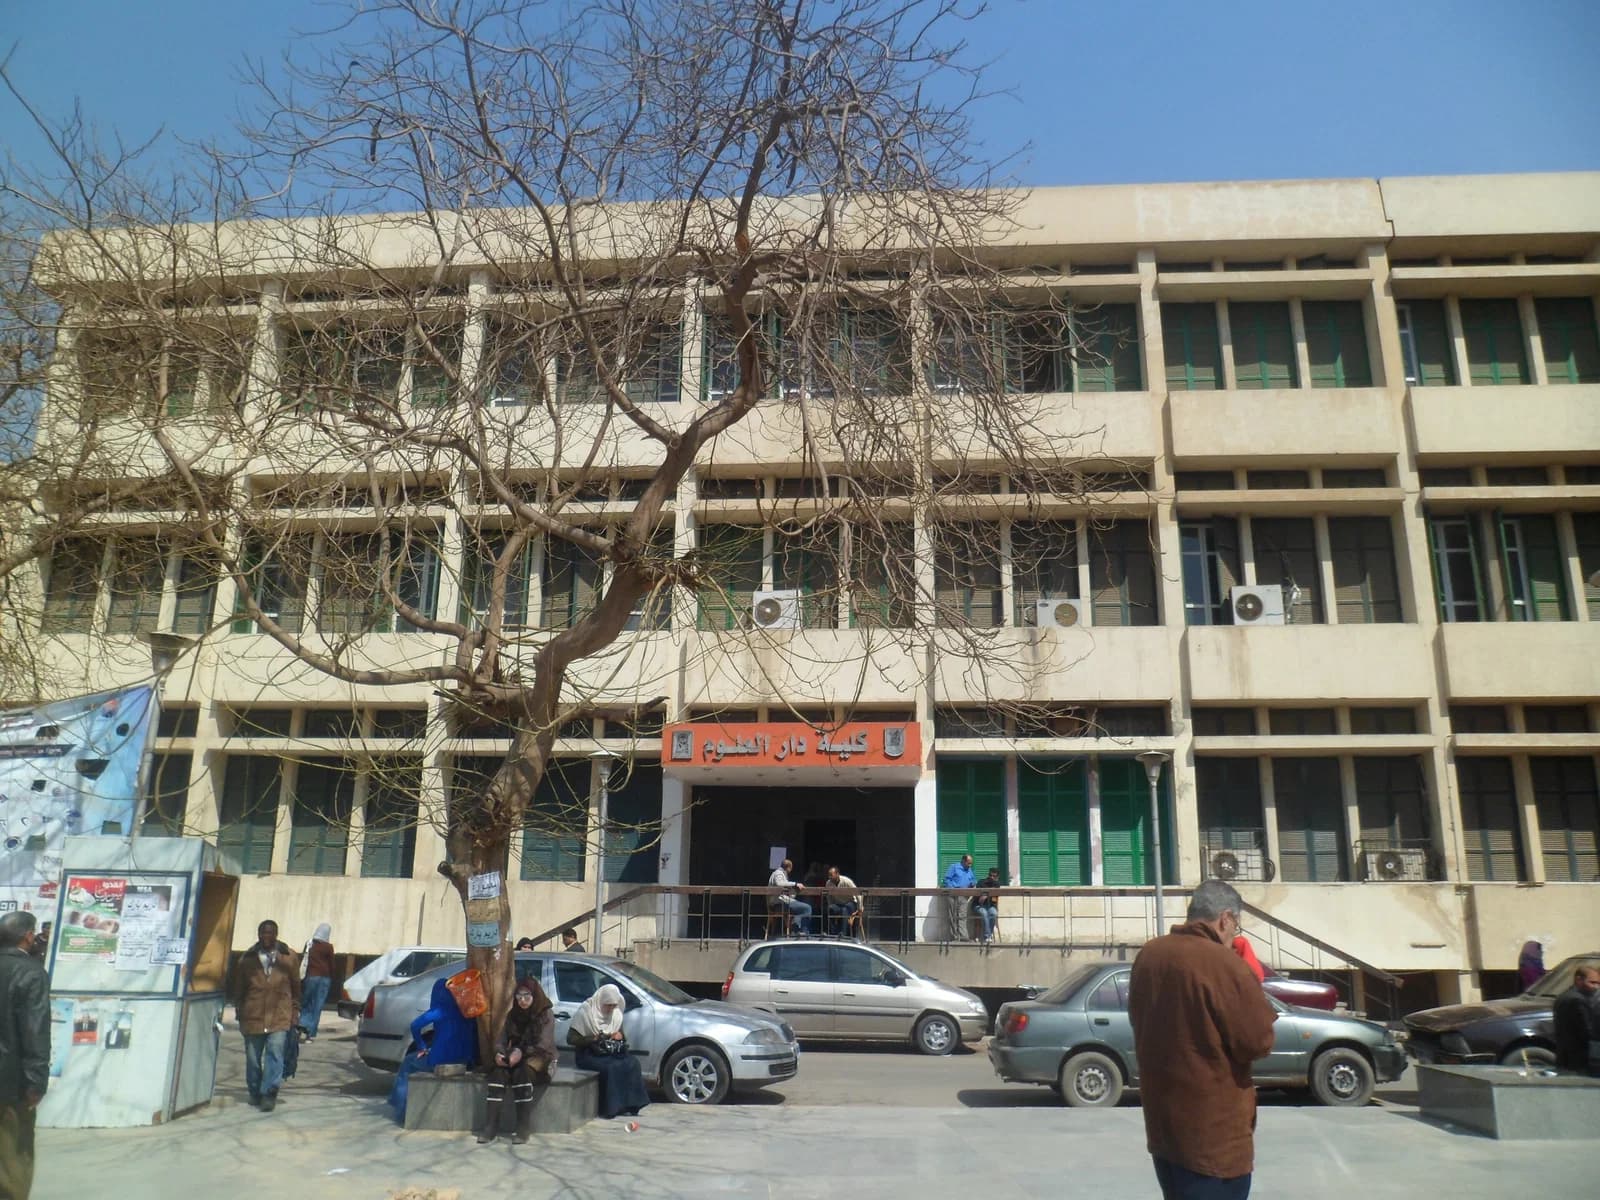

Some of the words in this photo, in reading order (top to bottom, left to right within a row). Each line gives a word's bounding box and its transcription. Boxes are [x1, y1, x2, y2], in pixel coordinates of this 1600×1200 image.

[702, 734, 768, 762] العلوم
[774, 734, 806, 761] دار
[815, 729, 868, 761] كلية
